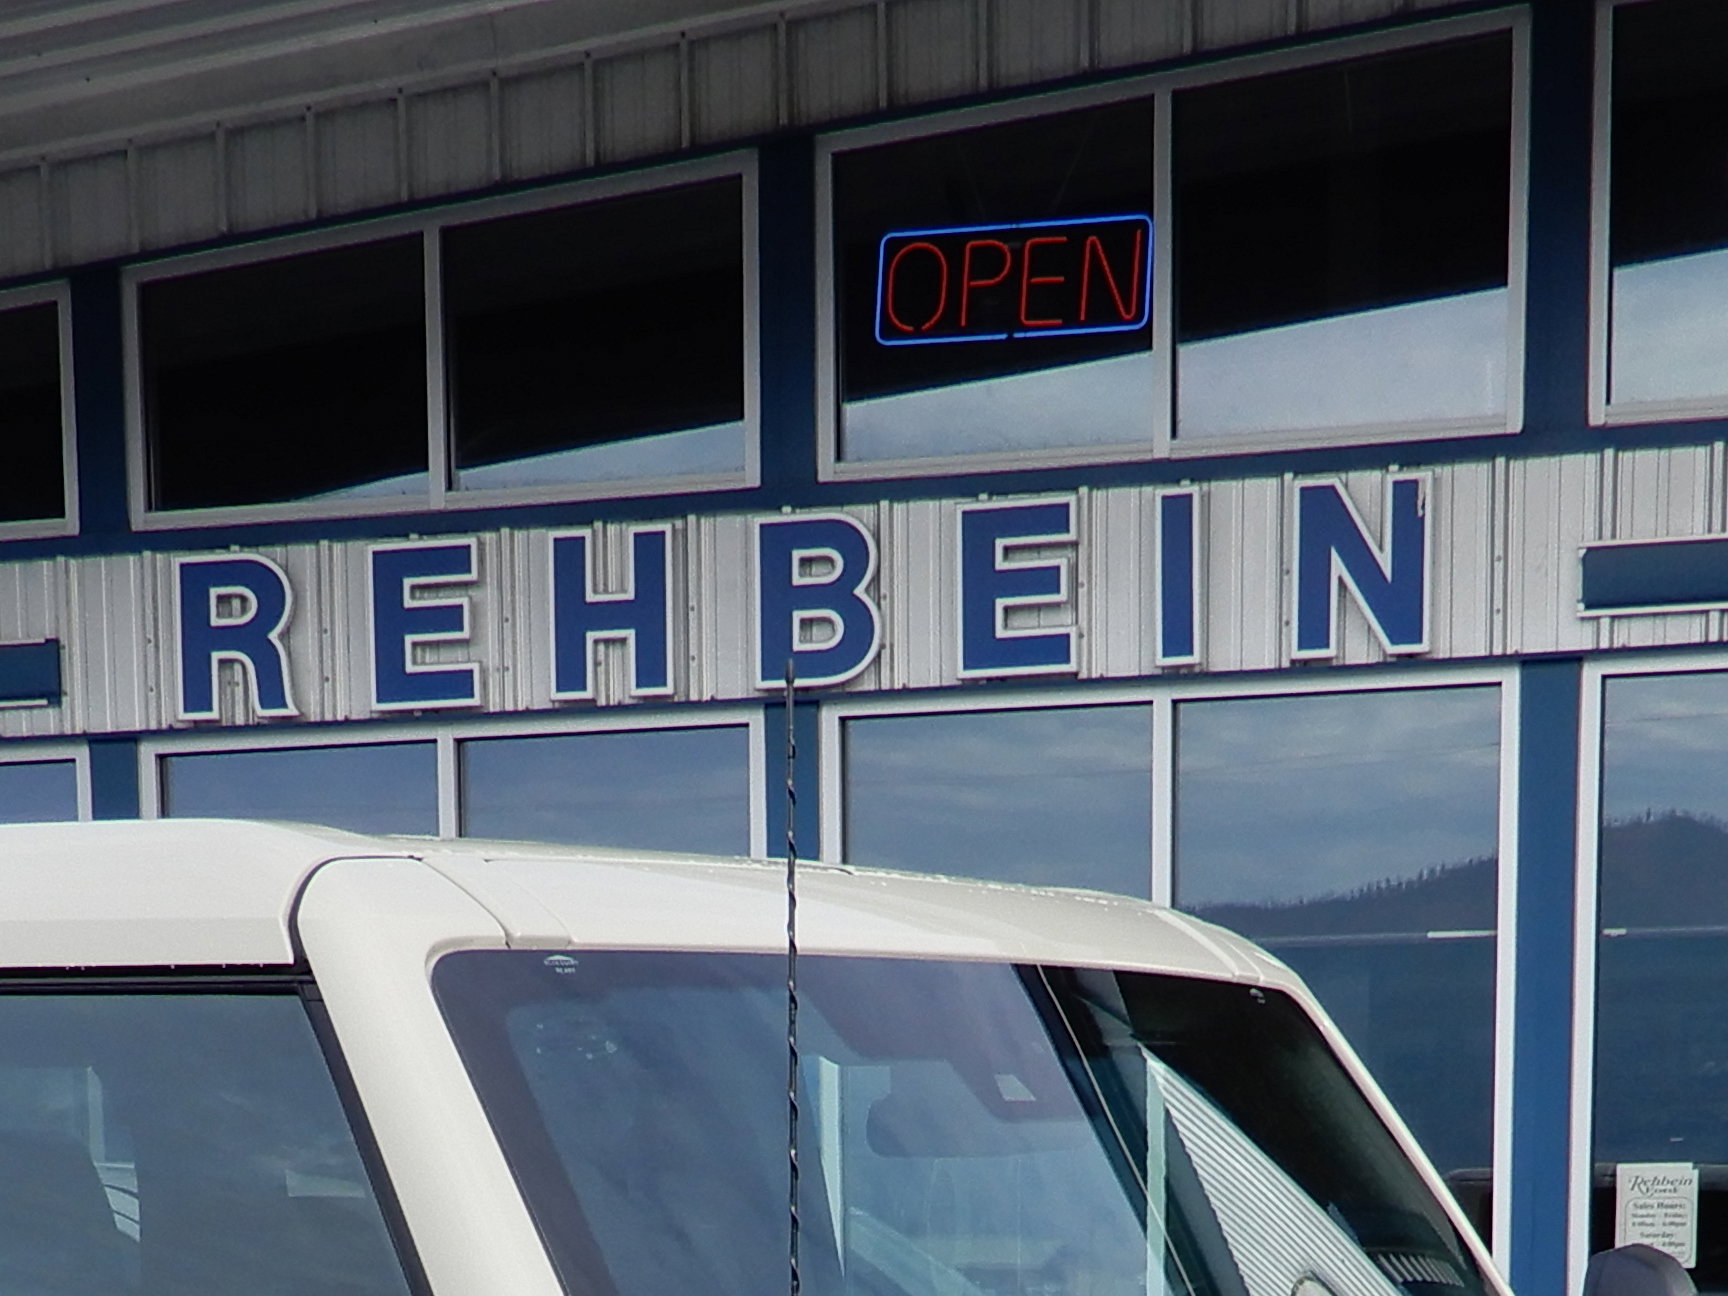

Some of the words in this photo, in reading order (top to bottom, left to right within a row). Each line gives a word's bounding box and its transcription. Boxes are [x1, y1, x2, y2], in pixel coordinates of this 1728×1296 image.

[886, 227, 1143, 333] OPEN
[174, 468, 1434, 722] REHBEIN
[1628, 1175, 1693, 1196] Rehbein
